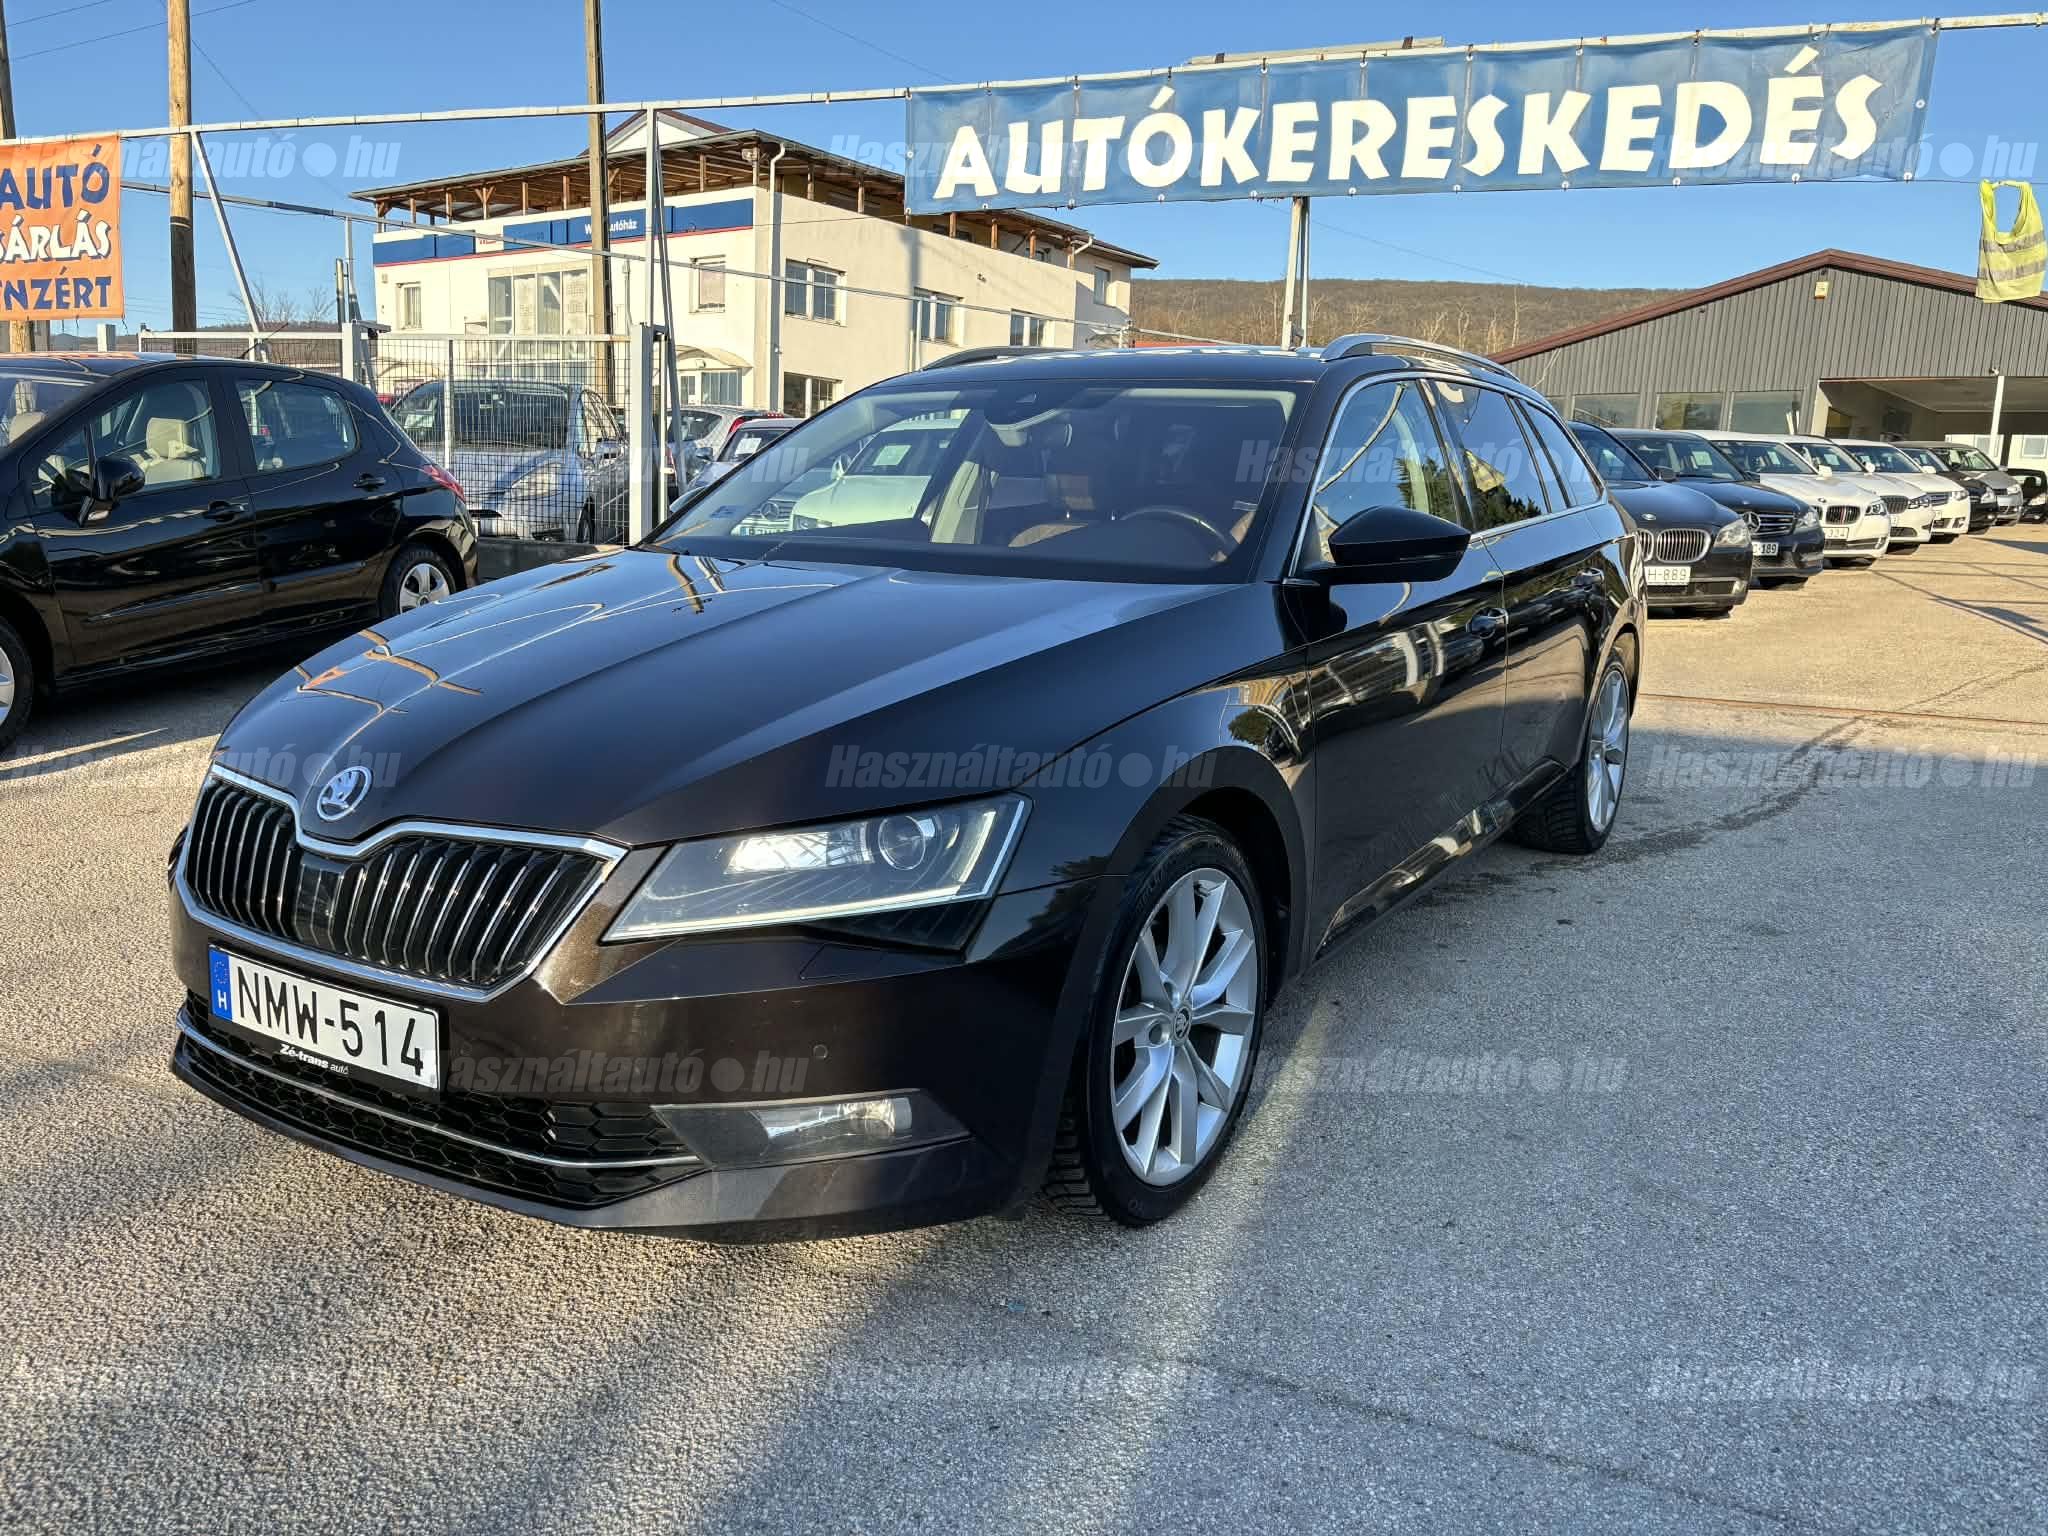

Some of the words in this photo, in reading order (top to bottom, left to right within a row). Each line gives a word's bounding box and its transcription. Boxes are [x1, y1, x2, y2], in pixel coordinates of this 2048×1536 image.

[933, 45, 1883, 199] AUTÓKERESKEDÉS
[0, 144, 110, 211] AUTÓ
[0, 208, 112, 263] ÁRLÁS
[0, 266, 112, 311] NZÉRT
[217, 989, 228, 1012] H
[237, 966, 424, 1077] NMW-514
